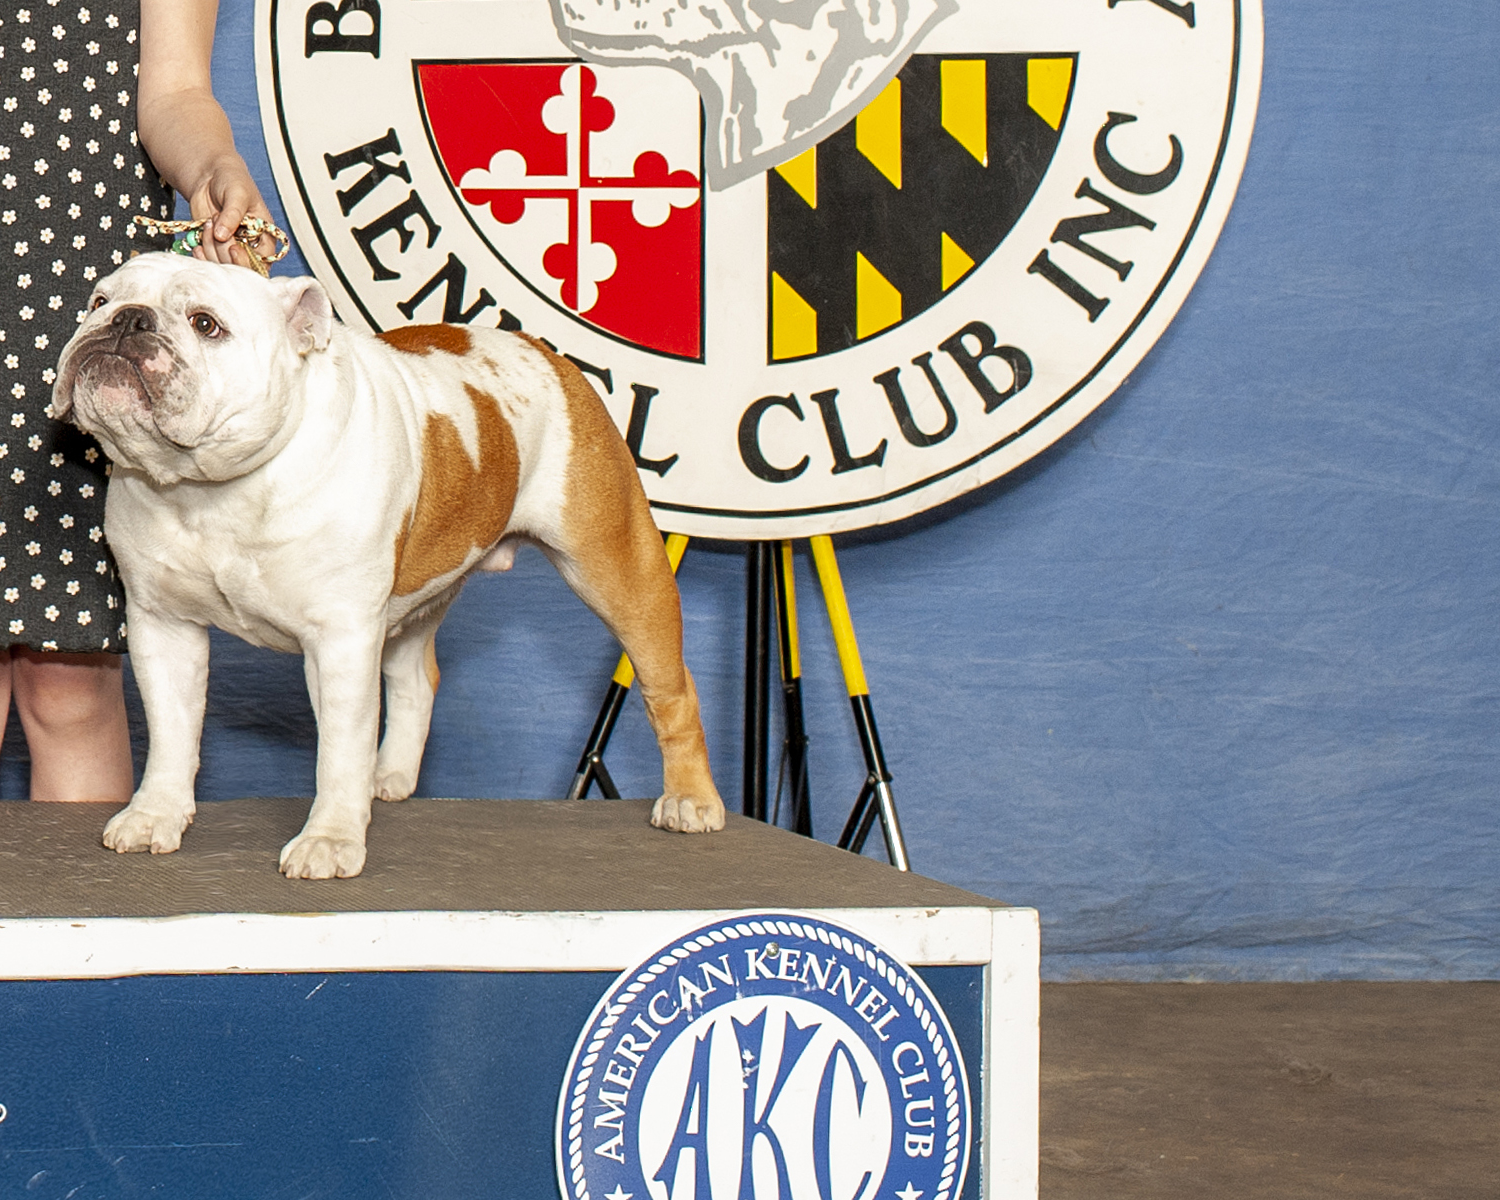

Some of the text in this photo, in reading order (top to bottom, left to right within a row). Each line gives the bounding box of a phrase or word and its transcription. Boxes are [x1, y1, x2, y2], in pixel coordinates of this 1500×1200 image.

[323, 111, 1184, 484] KENL CLUB INC
[594, 946, 936, 1164] AMERICAN KENNEL CLUB
[652, 1005, 874, 1200] AKC
